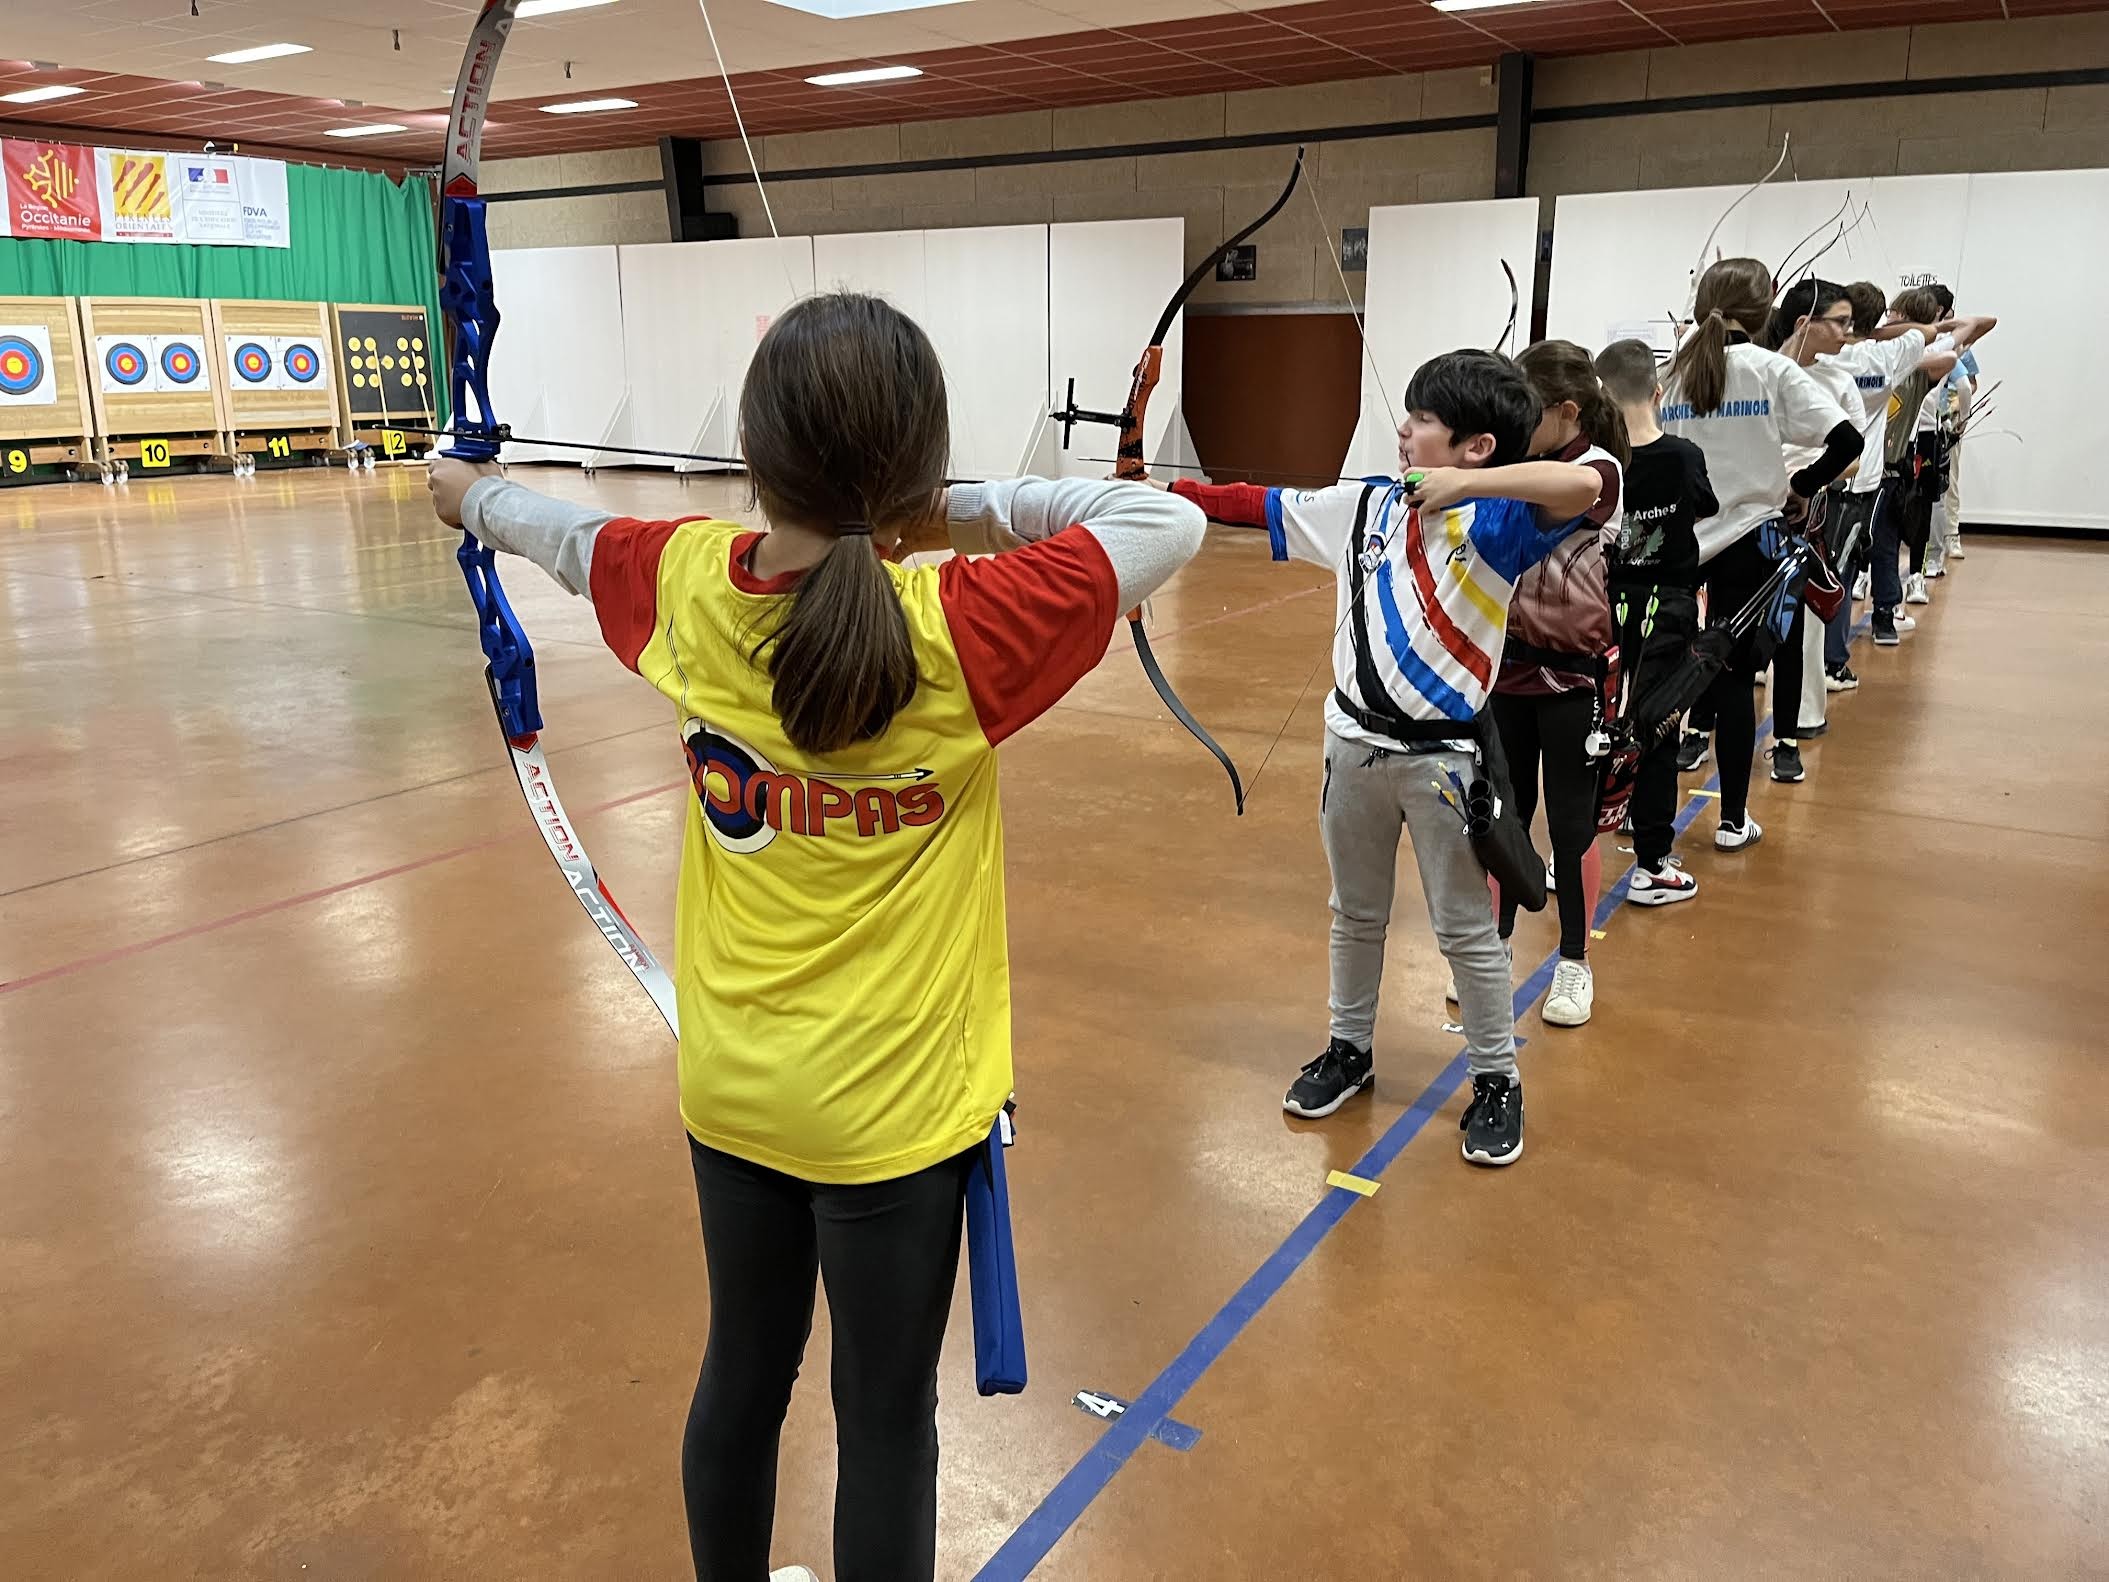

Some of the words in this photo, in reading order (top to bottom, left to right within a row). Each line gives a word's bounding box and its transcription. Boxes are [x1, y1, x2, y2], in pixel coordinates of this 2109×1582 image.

[457, 40, 496, 166] ACTION
[20, 208, 91, 227] Occitanie
[243, 206, 268, 217] FDVA
[145, 444, 166, 462] 10
[268, 436, 289, 458] 11
[8, 449, 28, 473] 9
[523, 761, 580, 862] ACTION
[562, 868, 646, 975] ACTION
[1077, 1391, 1126, 1417] 4
